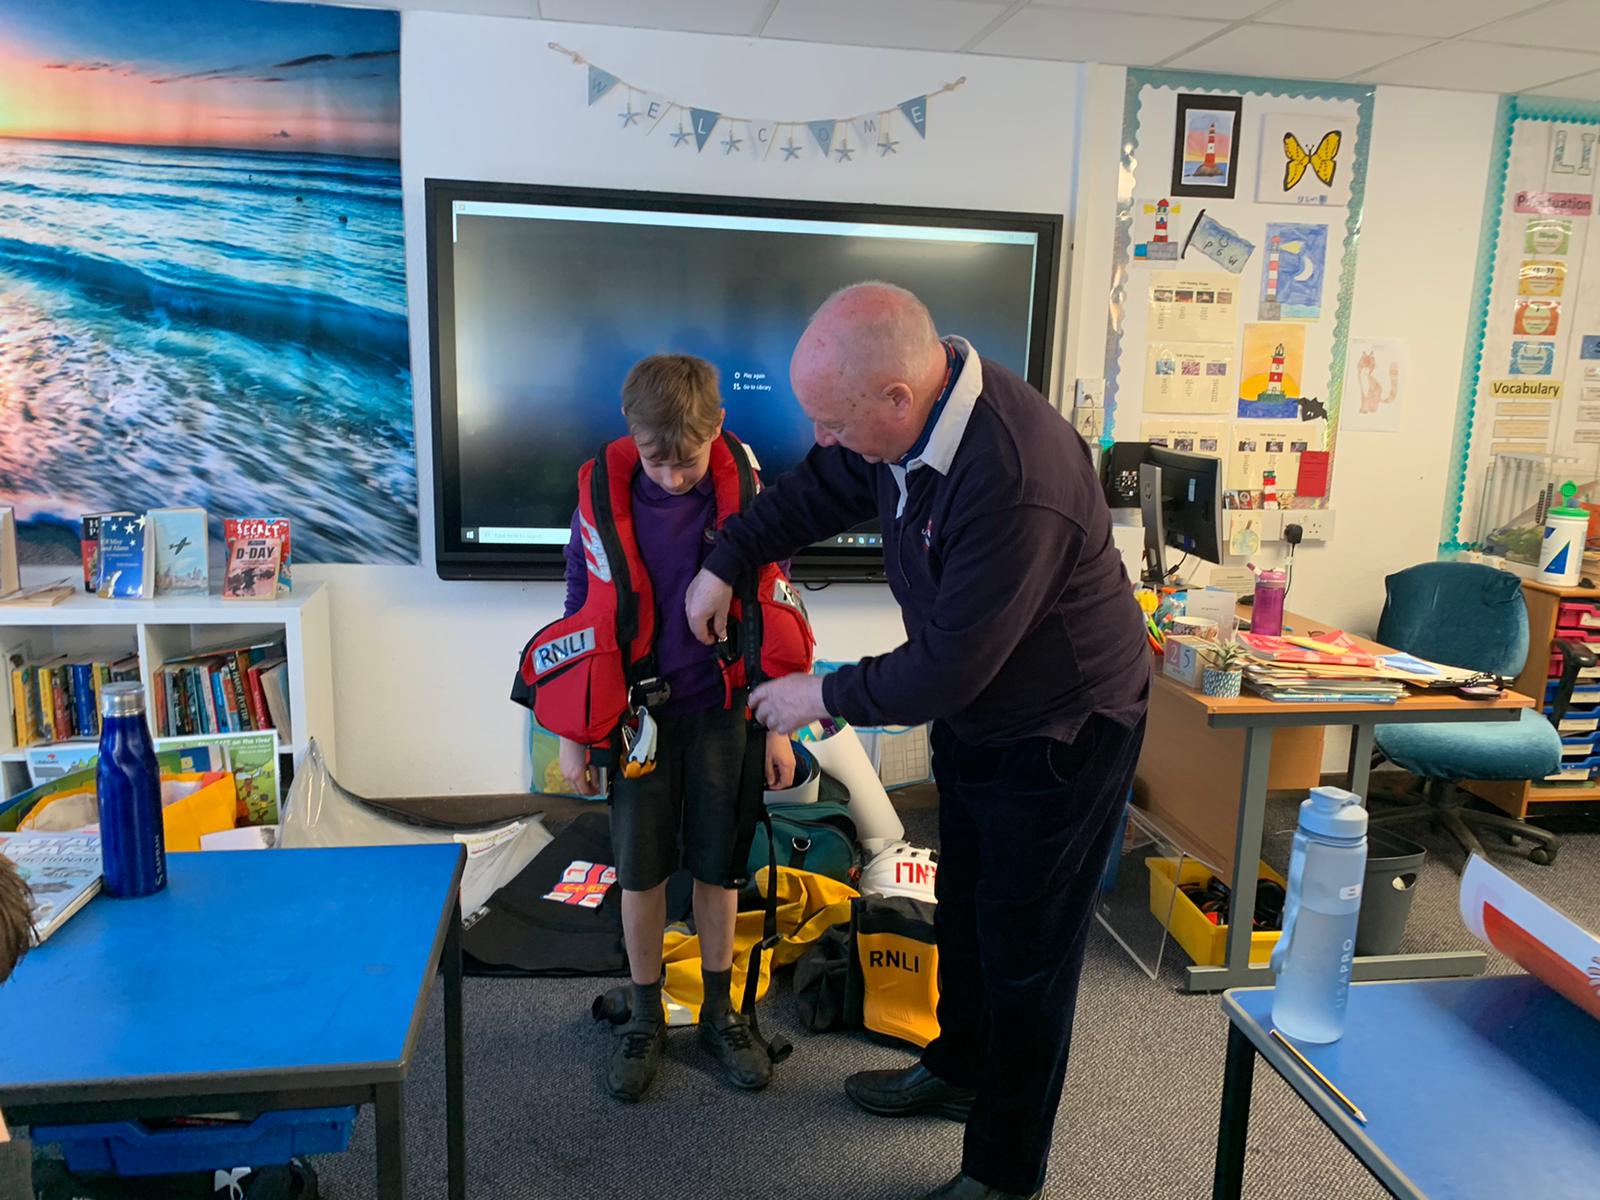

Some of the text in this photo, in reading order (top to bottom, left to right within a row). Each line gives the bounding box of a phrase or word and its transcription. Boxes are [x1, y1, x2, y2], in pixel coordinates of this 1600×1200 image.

[1494, 381, 1560, 397] Vocabulary
[237, 523, 279, 538] SECRET
[236, 547, 274, 559] D-DAY
[539, 632, 585, 668] RNLI
[870, 950, 920, 973] RNLI
[1339, 939, 1353, 973] PRO
